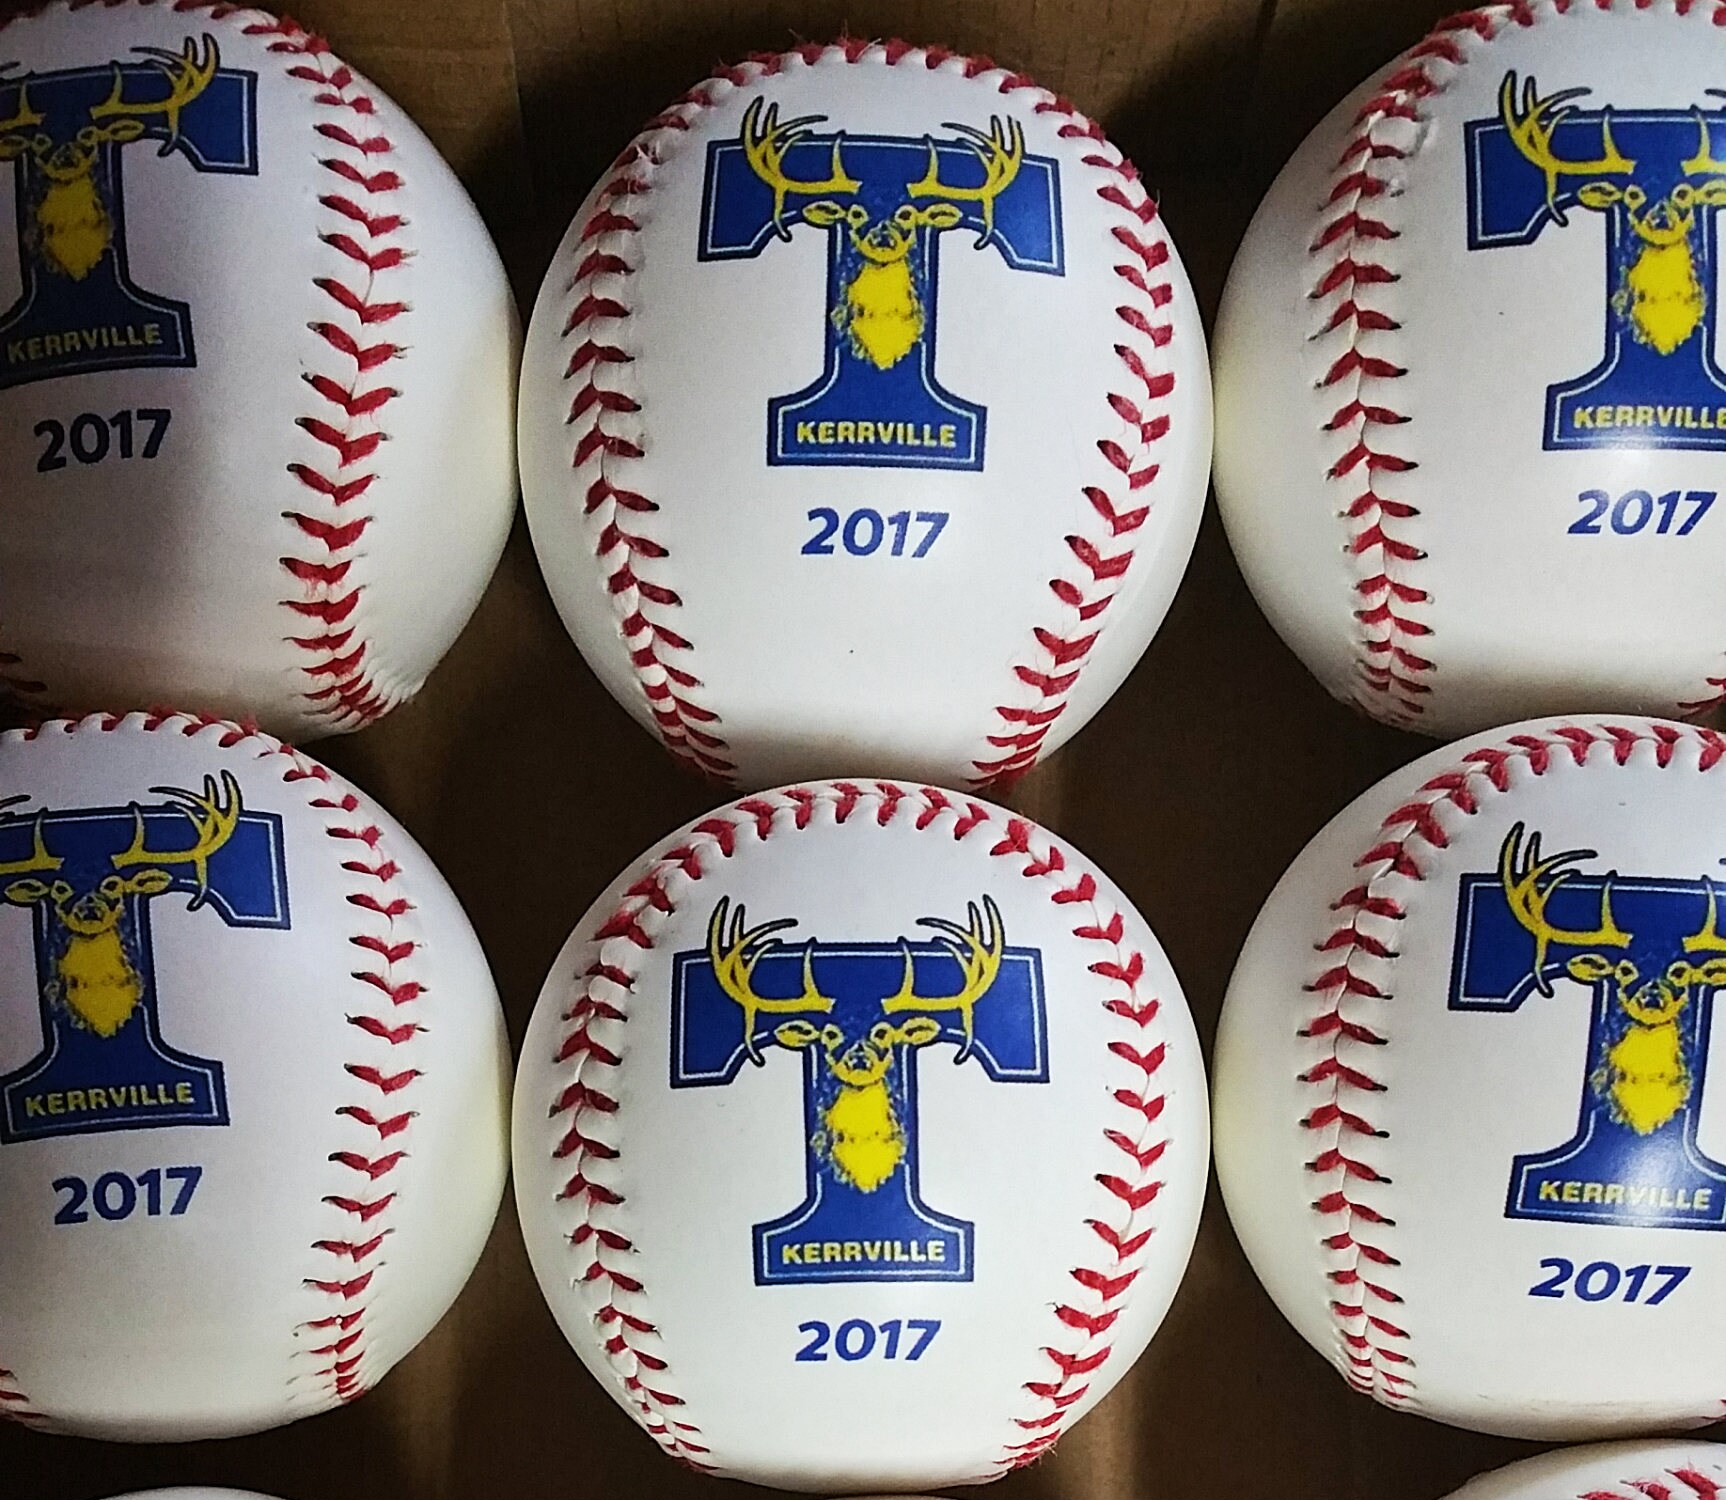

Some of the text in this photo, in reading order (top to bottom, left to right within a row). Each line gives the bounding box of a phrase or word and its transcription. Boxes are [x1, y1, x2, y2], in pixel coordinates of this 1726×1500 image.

[7, 322, 163, 364] KERRVILLE
[33, 408, 171, 473] 2017
[796, 421, 957, 448] KERRVILLE
[801, 507, 949, 558] 2017
[1567, 489, 1717, 536] 2017
[24, 1081, 195, 1118] KERRVILLE
[52, 1165, 202, 1225] 2017
[1539, 1180, 1712, 1210] KERRVILLE
[782, 1240, 945, 1264] KERRVILLE
[1528, 1257, 1692, 1305] 2017
[795, 1318, 942, 1362] 2017
